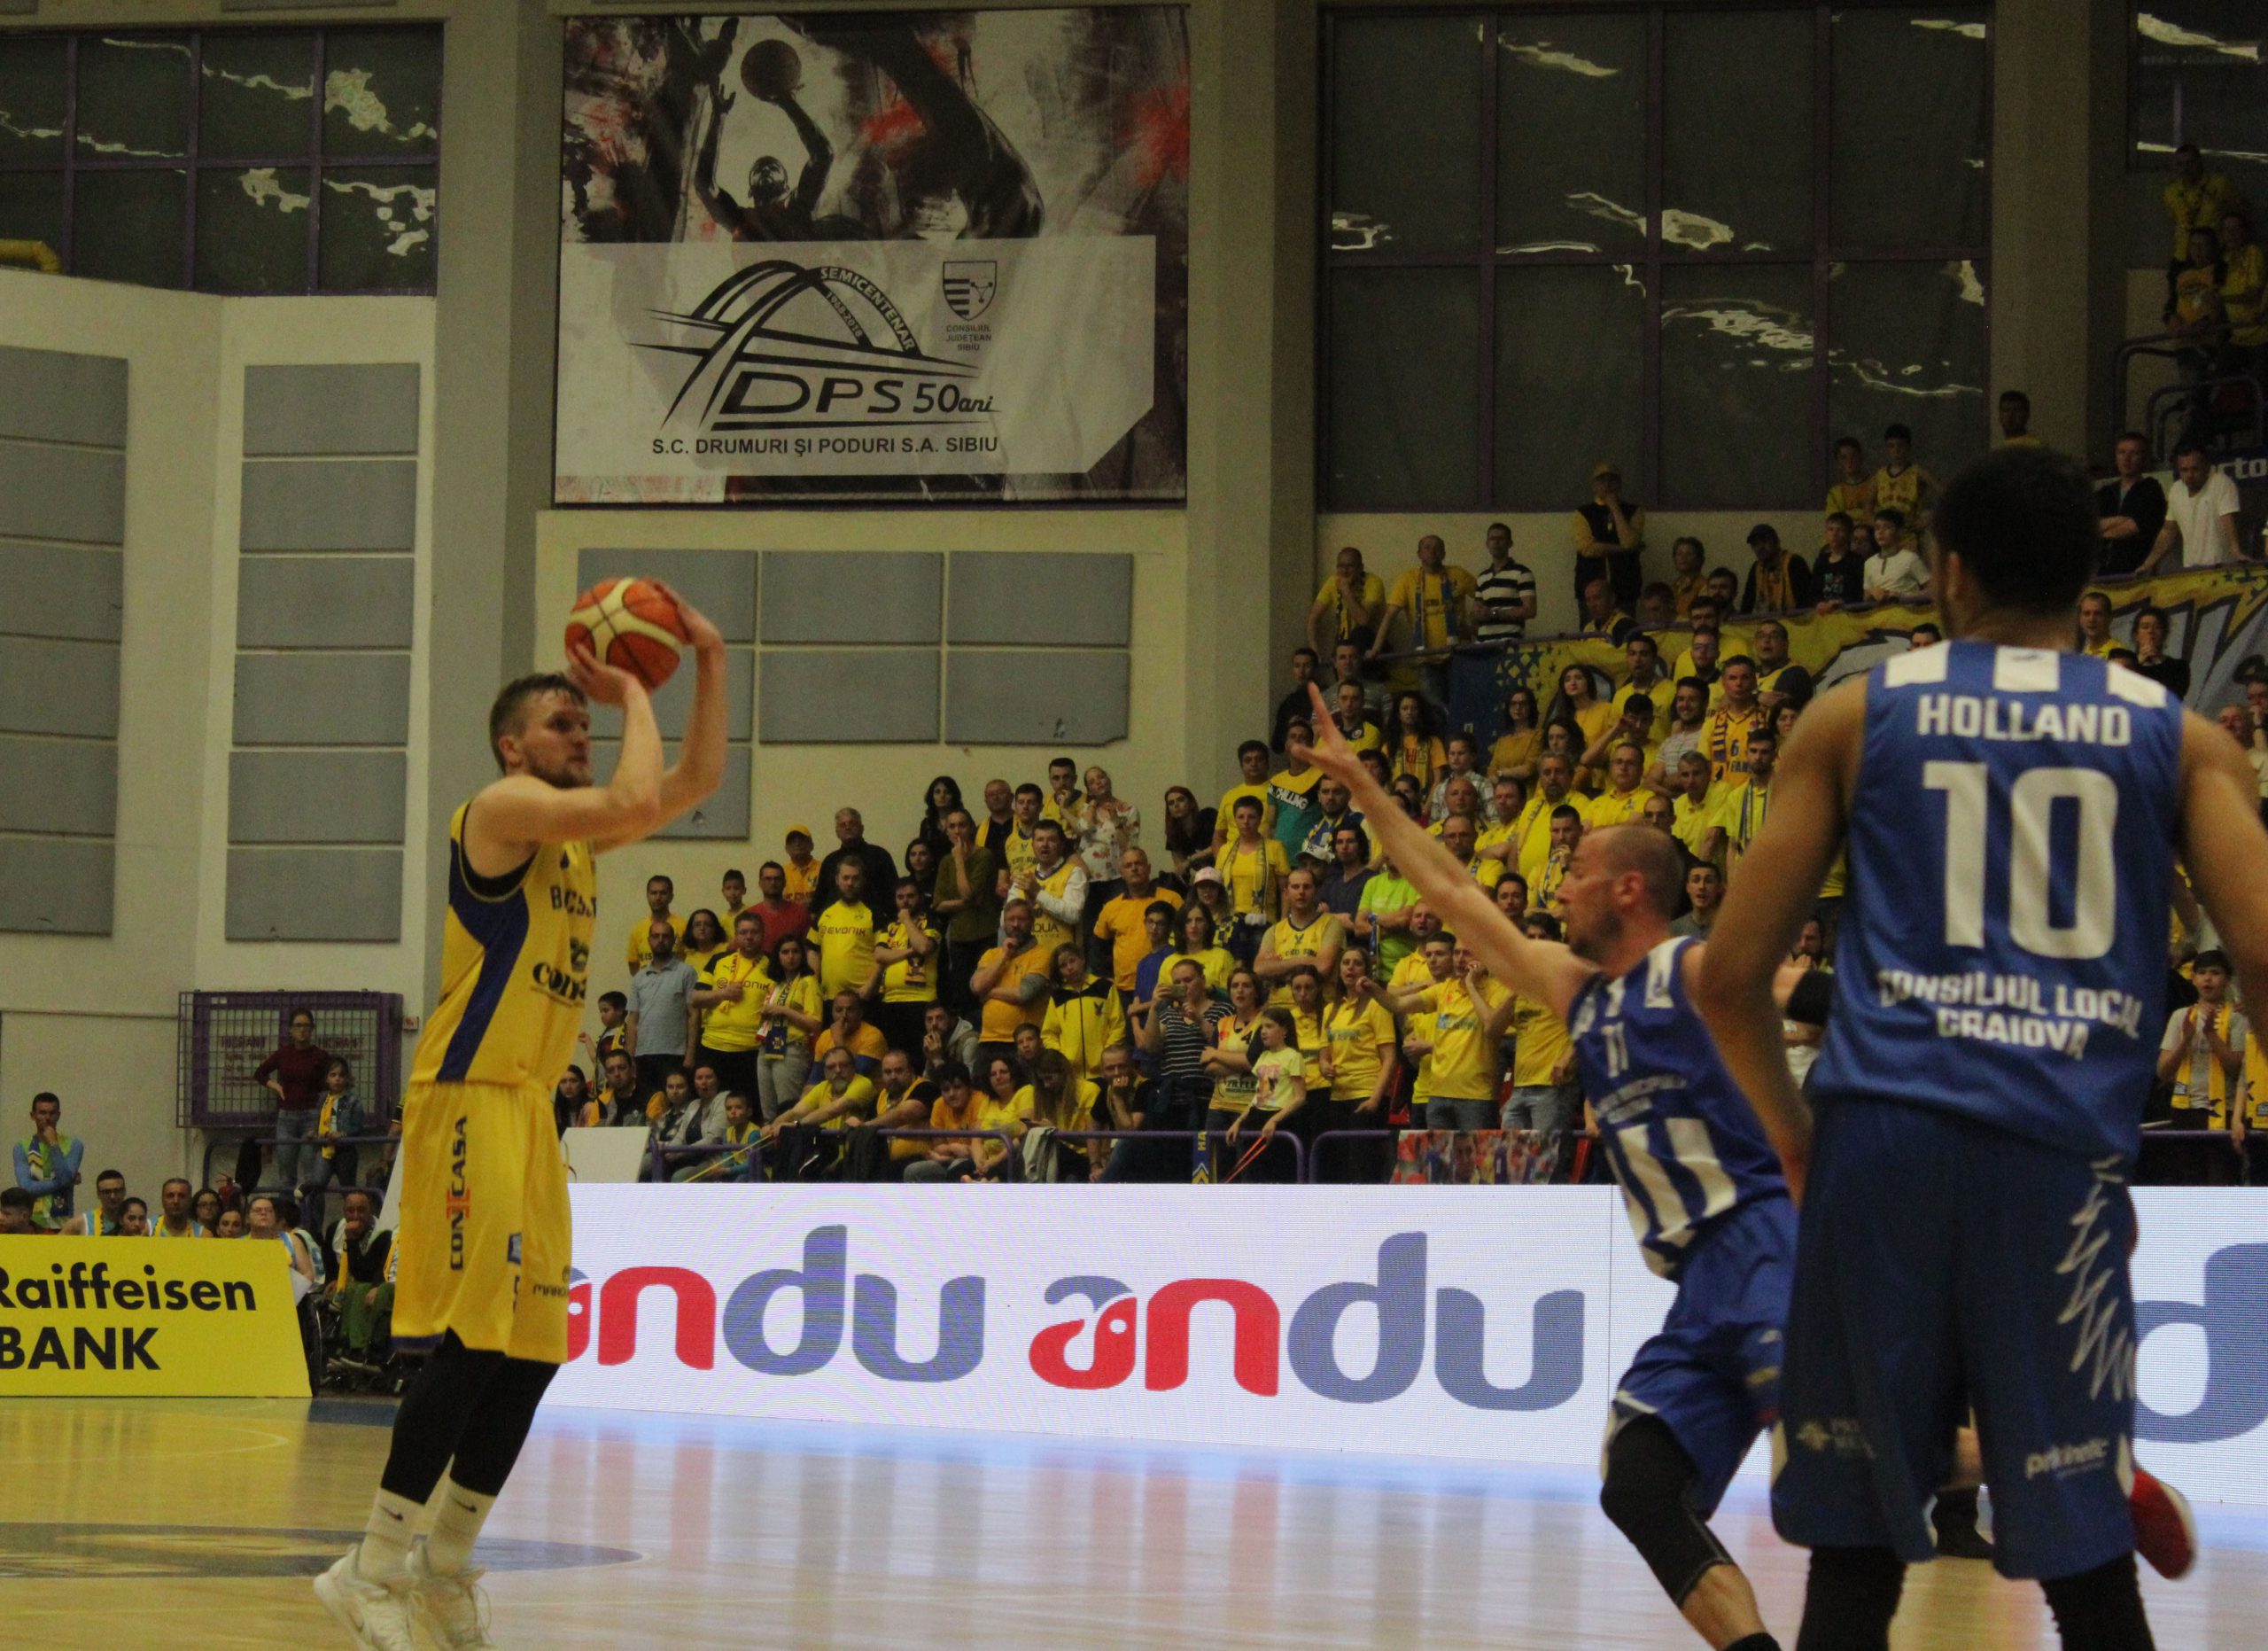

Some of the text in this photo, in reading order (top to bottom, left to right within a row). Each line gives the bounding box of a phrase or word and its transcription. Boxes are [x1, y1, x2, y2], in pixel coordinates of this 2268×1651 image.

[820, 268, 916, 351] SEMICENTENAR
[718, 370, 902, 415] DPS
[652, 439, 689, 455] S.C.
[695, 438, 788, 454] DRUMURI
[819, 437, 895, 454] PODURI
[901, 437, 939, 453] S.A.
[945, 436, 998, 453] SIBIU
[1916, 694, 2132, 746] HOLLAND
[1922, 760, 2118, 959] 10
[1937, 1007, 2090, 1061] CRAIOVA
[567, 1225, 1586, 1413] ndu andu
[0, 1327, 161, 1370] BANK
